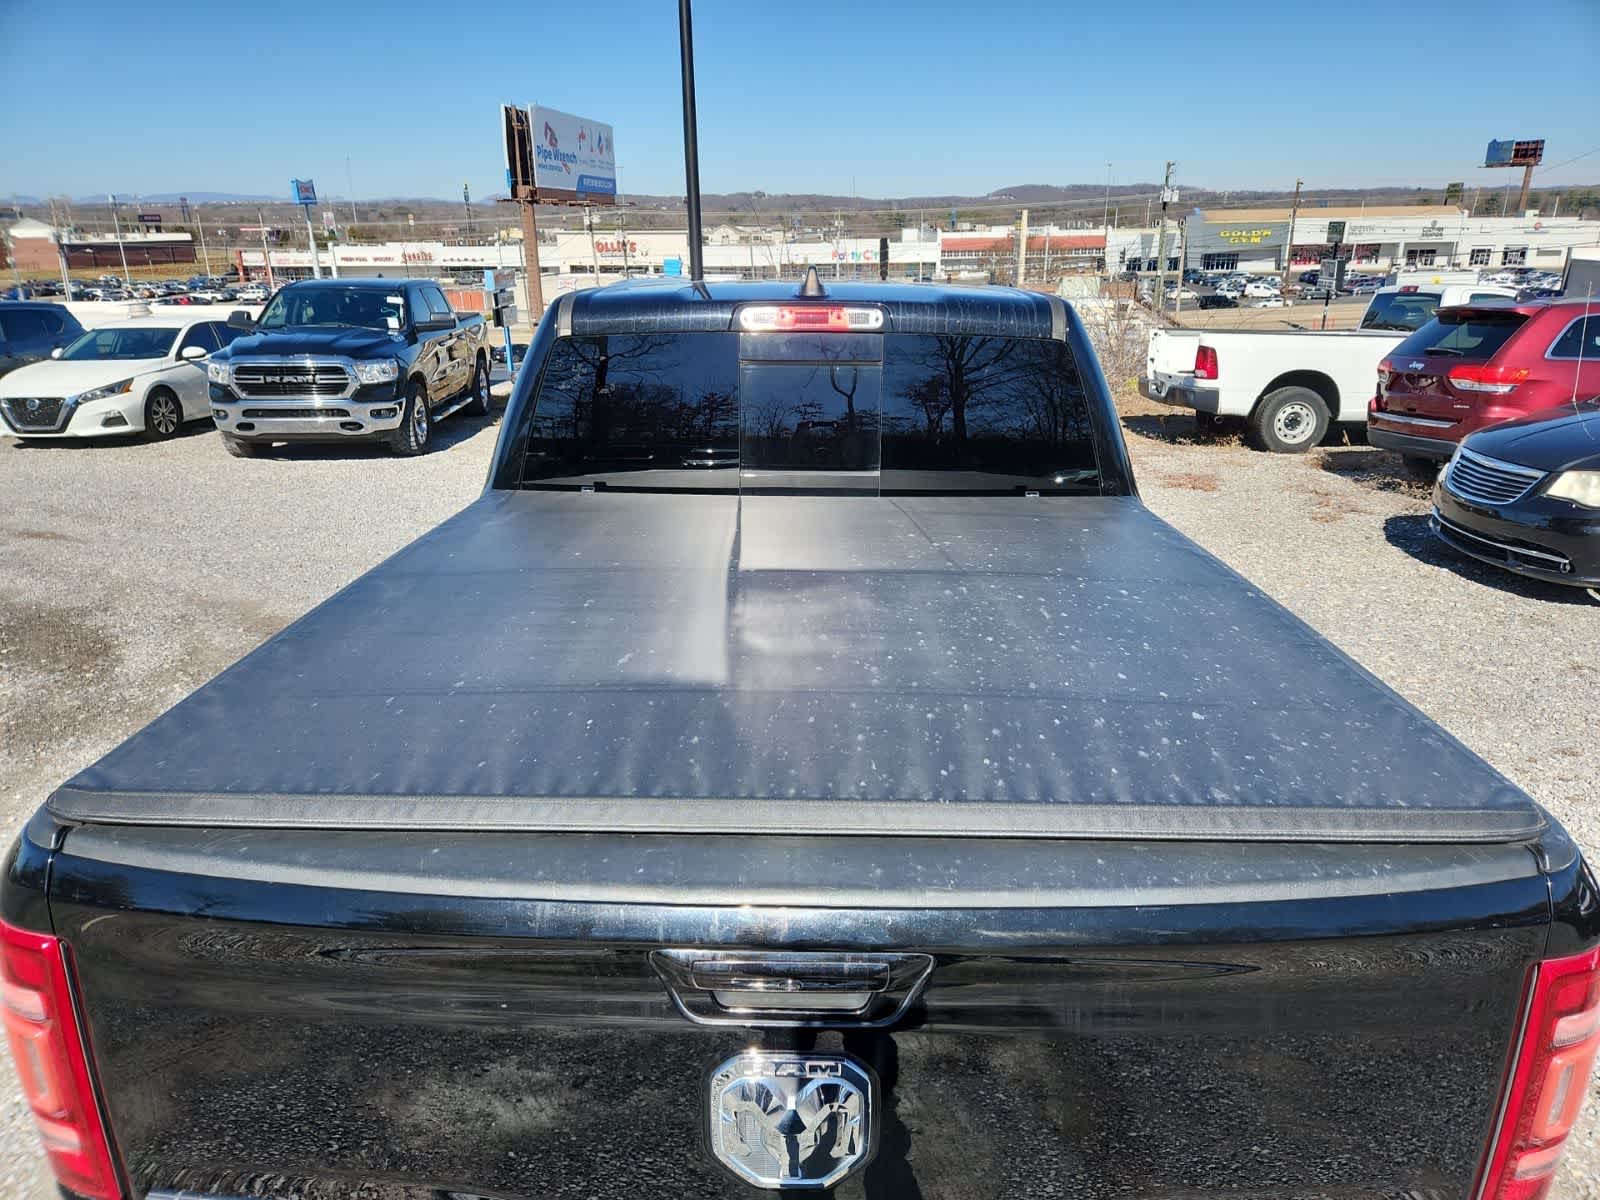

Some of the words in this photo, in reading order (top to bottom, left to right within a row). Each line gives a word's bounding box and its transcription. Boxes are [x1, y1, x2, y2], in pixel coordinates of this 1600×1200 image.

[537, 144, 552, 163] Pipe
[552, 148, 576, 163] Wrench
[265, 375, 314, 384] RAM
